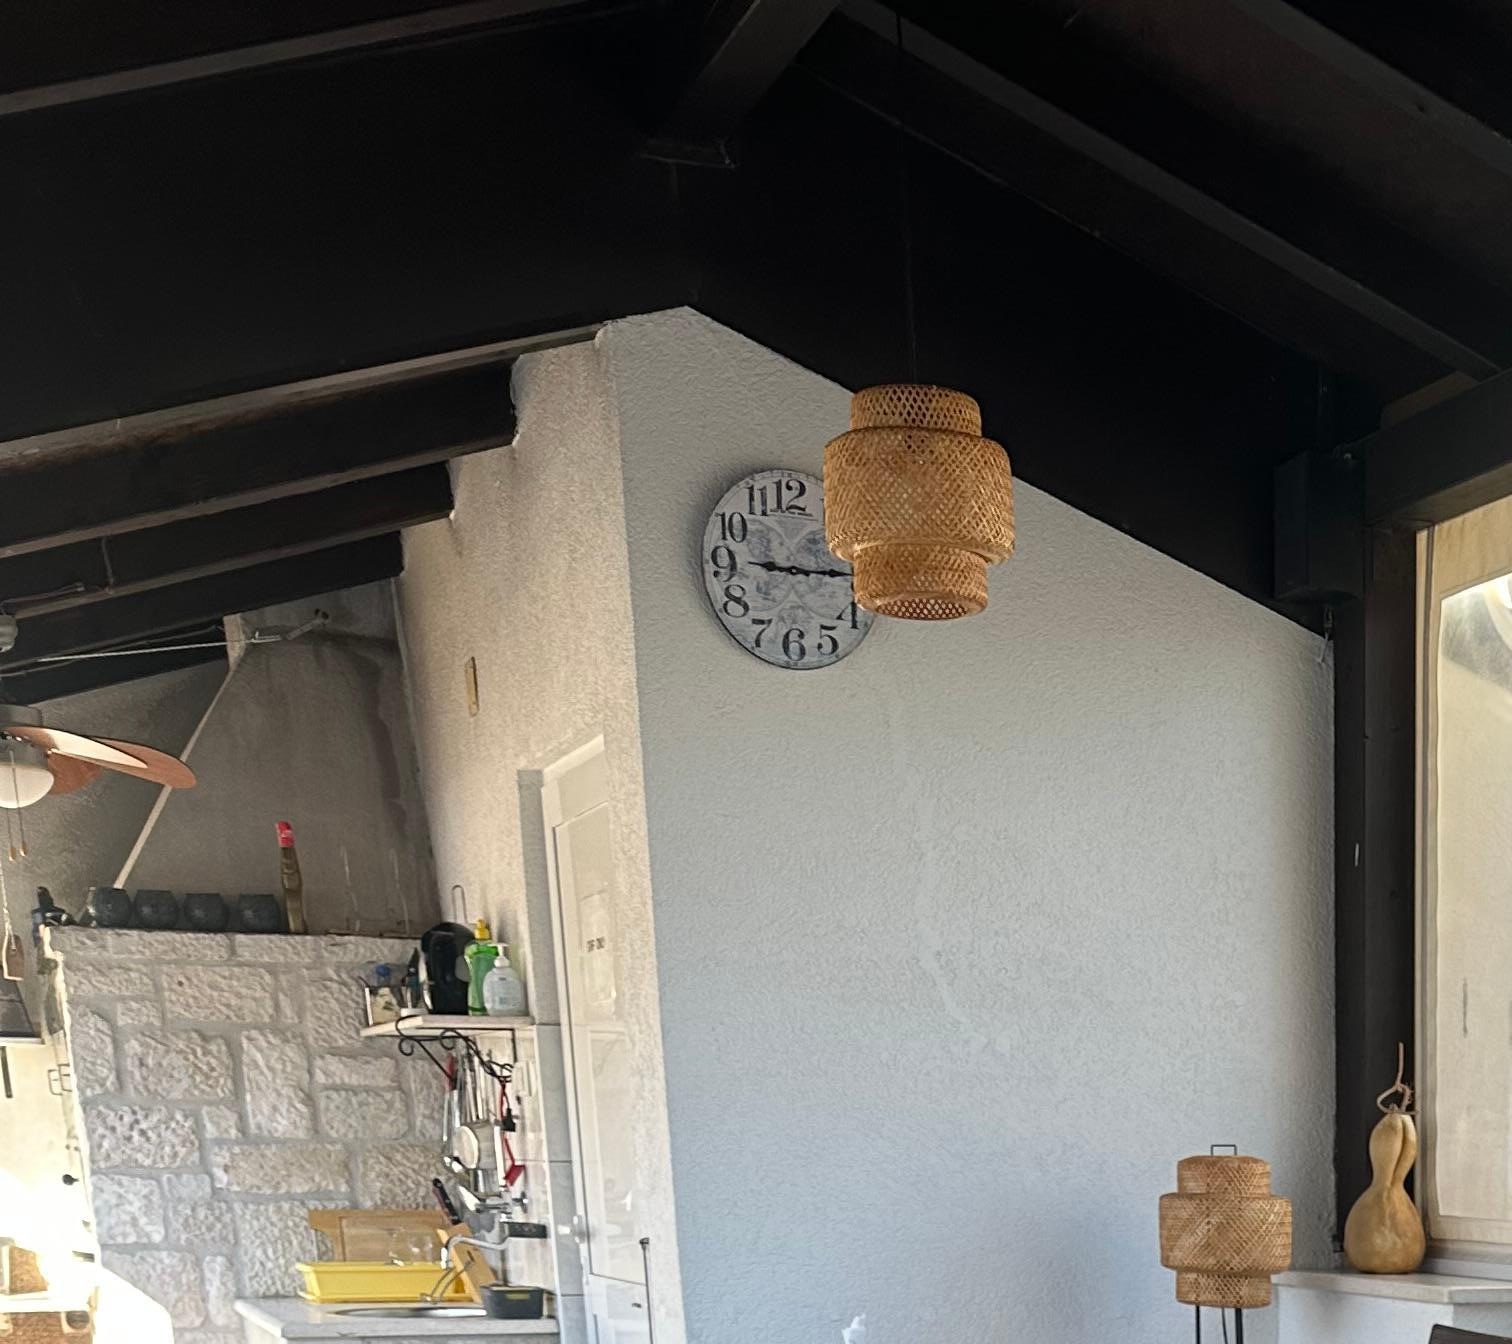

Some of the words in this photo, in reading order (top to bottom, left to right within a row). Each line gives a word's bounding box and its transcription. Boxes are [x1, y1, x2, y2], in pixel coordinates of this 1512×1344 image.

[746, 484, 768, 516] 11
[771, 478, 808, 513] 12
[714, 511, 748, 543] 10
[711, 545, 738, 583] 9
[722, 583, 750, 618] 8
[751, 617, 773, 648] 7
[782, 627, 806, 662] 6
[817, 624, 840, 656] 5
